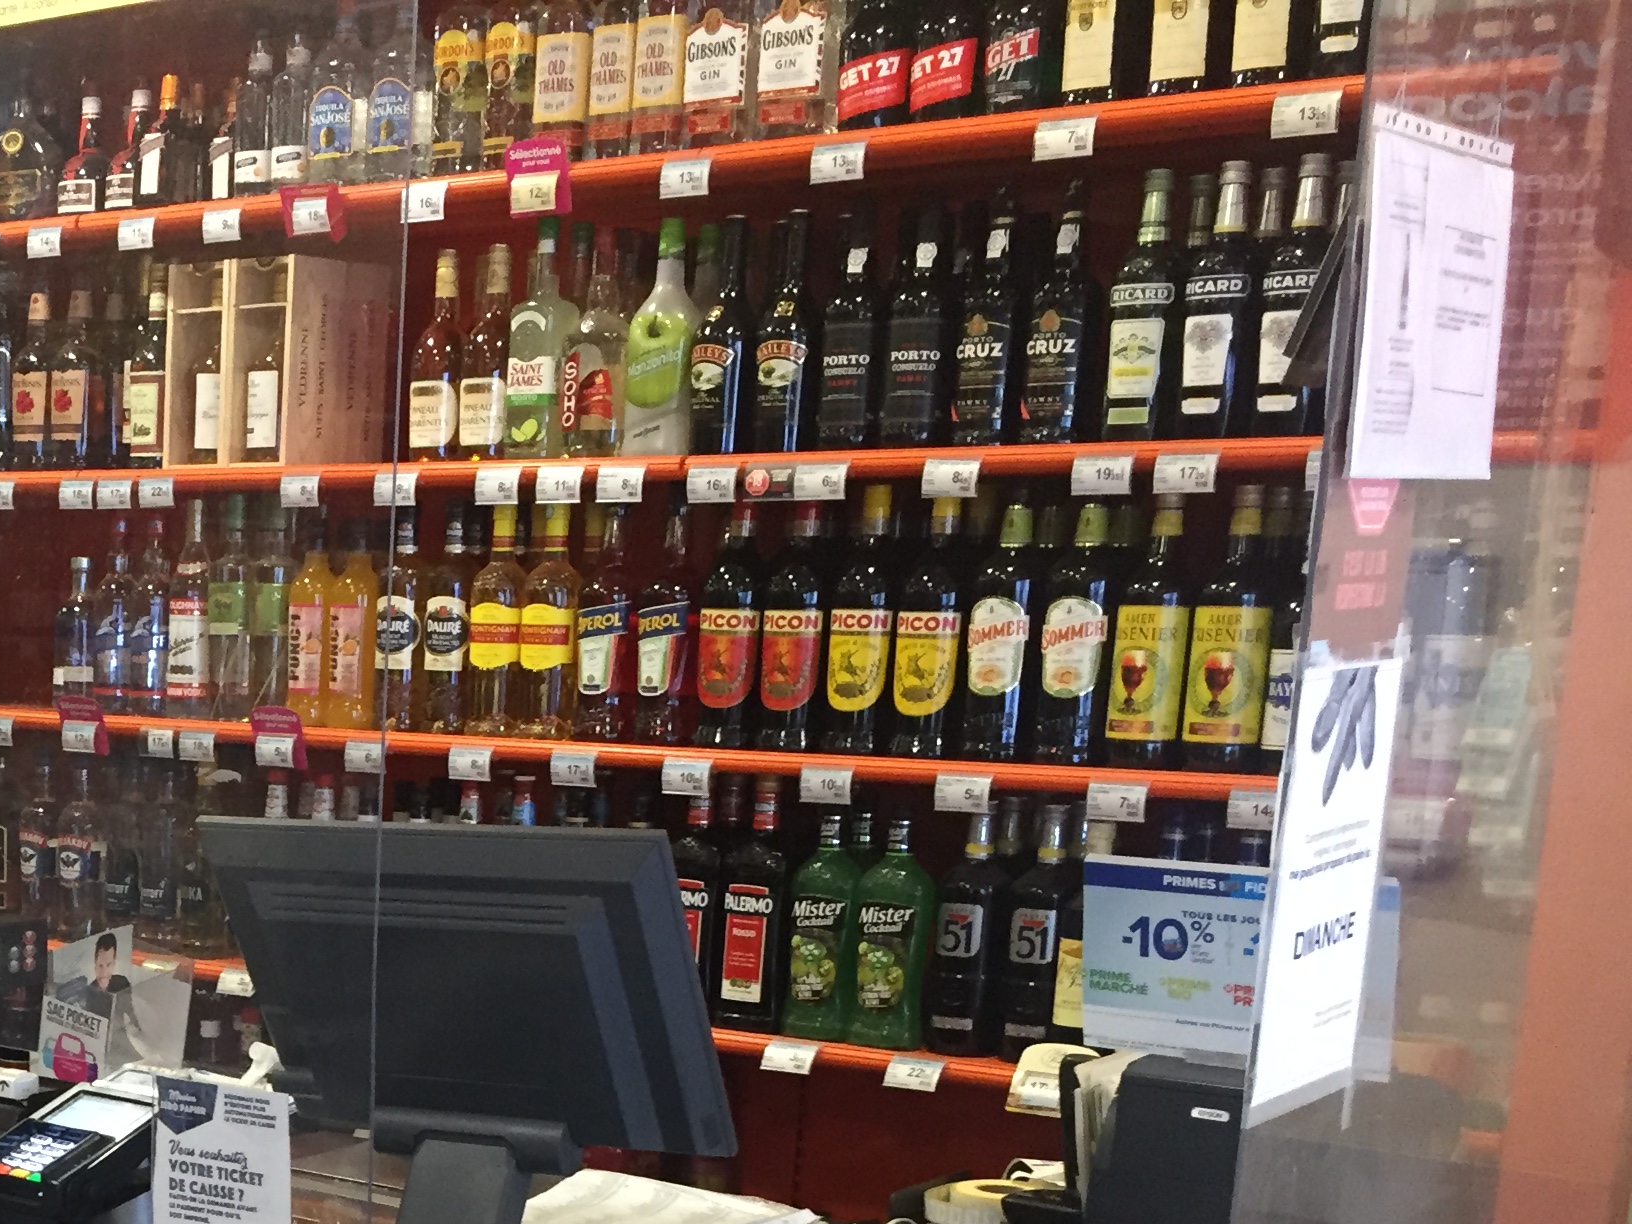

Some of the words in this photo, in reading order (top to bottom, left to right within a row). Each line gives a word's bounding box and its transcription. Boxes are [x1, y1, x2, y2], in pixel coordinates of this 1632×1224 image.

[763, 24, 814, 51] GIBSON'S
[646, 43, 664, 59] OLD
[687, 36, 736, 63] GIBSON'S
[938, 45, 964, 69] 27
[987, 33, 1034, 68] GET
[547, 59, 566, 76] OLD
[600, 51, 617, 67] OLD
[775, 58, 796, 70] GIN
[591, 69, 626, 86] THAMES
[637, 60, 673, 79] THAMES
[700, 69, 720, 80] GIN
[840, 62, 873, 91] GET
[876, 56, 900, 78] 27
[997, 61, 1016, 82] 27
[539, 76, 574, 94] THAMES
[509, 144, 562, 161] Sélectionné
[1112, 286, 1169, 303] RICARD
[1185, 278, 1243, 295] RICARD
[962, 336, 993, 344] PORTO
[1033, 331, 1066, 340] PORTO
[956, 341, 1003, 360] CRUZ
[1026, 338, 1076, 355] CRUZ
[823, 354, 870, 367] PORTO
[891, 350, 940, 362] PORTO
[510, 363, 543, 375] SAINT
[509, 374, 543, 388] JAMES
[562, 361, 578, 427] SOHO
[427, 619, 461, 633] DAURÉ
[701, 613, 756, 629] PICON
[764, 614, 818, 629] PICON
[832, 614, 888, 629] PICON
[897, 615, 956, 631] PICON
[1209, 613, 1242, 625] AMER
[968, 618, 1028, 649] SOMMER
[1042, 618, 1105, 650] SOMMER
[1163, 875, 1216, 890] PRIMES
[725, 891, 773, 913] PALERMO
[792, 899, 845, 919] Mister
[796, 915, 836, 927] Cocktail
[859, 905, 914, 924] Mister
[1182, 910, 1212, 921] TOUS
[1217, 913, 1237, 922] LES
[864, 920, 907, 933] Cocktail
[940, 918, 975, 954] 51
[1016, 926, 1051, 962] 51
[1293, 911, 1356, 960] DIMANCHE
[1090, 968, 1131, 983] PRIME
[1089, 980, 1148, 996] MARCHÉ
[47, 1001, 65, 1018] SAC
[66, 1008, 101, 1032] POCKET
[169, 1139, 195, 1157] Vous
[198, 1147, 248, 1170] souhaitez
[169, 1159, 213, 1179] VOTRE
[216, 1167, 264, 1187] TICKET
[169, 1177, 185, 1192] DE
[189, 1181, 235, 1200] CAISSE
[238, 1189, 244, 1201] ?
